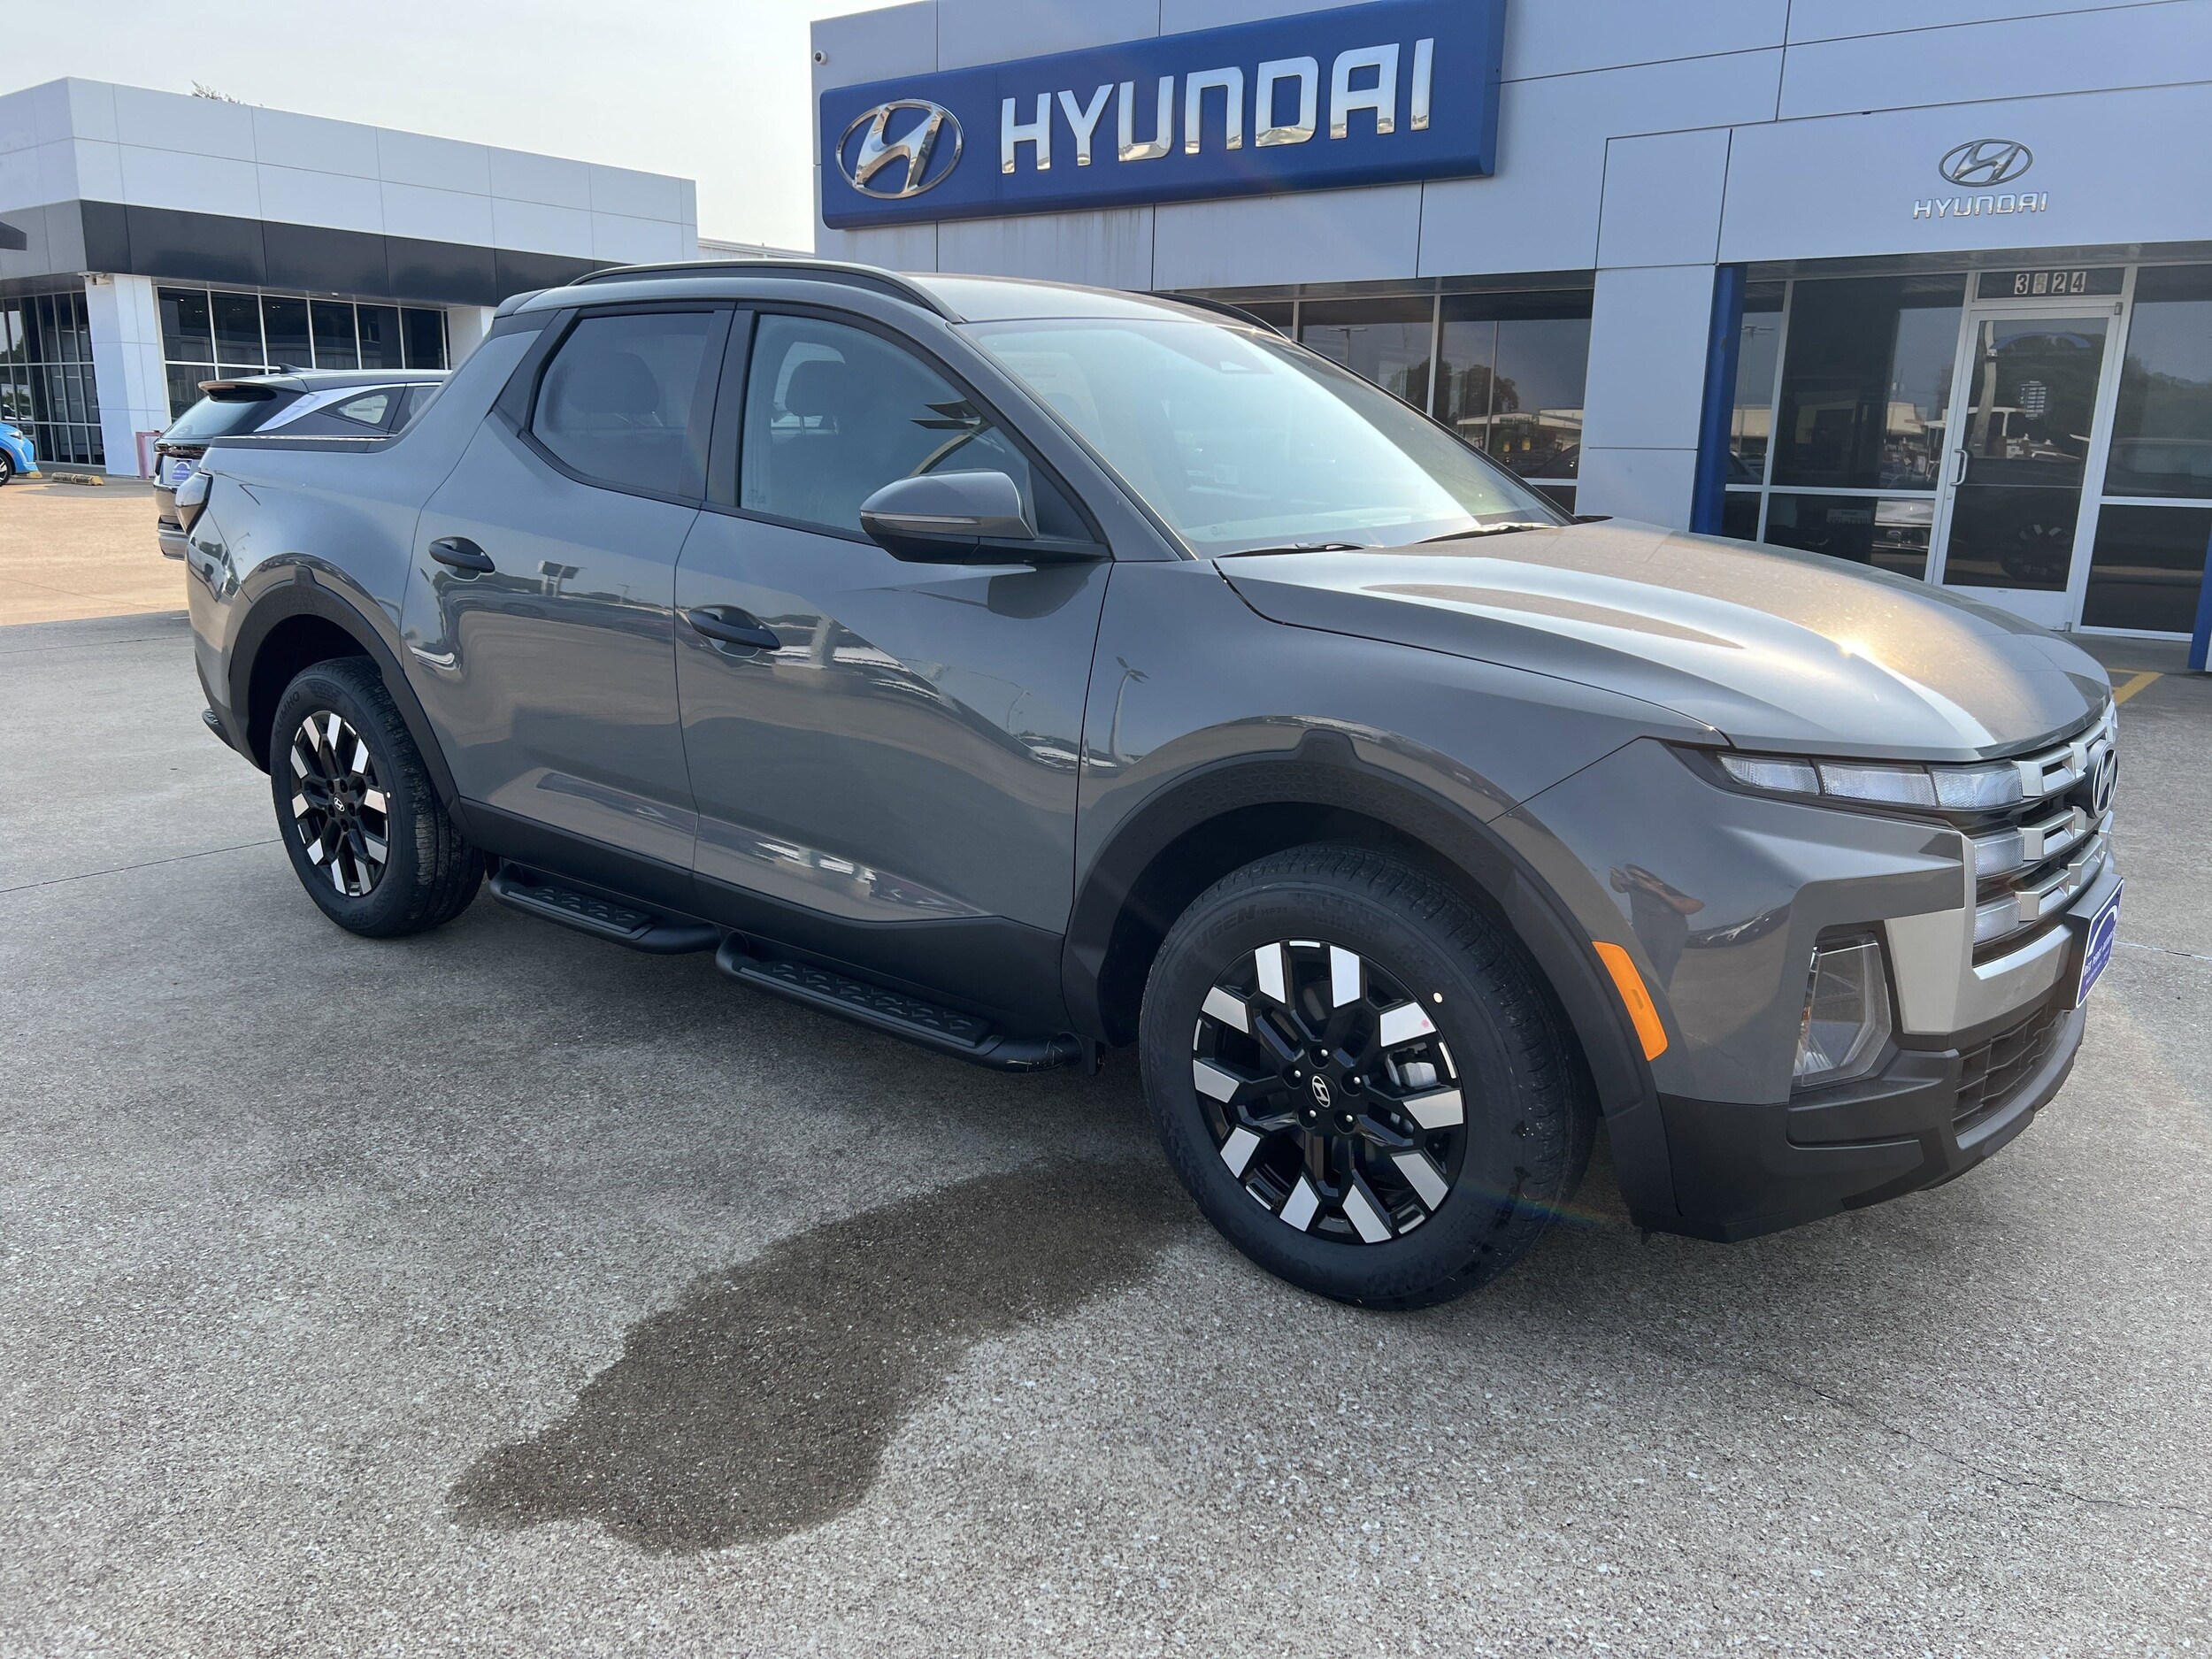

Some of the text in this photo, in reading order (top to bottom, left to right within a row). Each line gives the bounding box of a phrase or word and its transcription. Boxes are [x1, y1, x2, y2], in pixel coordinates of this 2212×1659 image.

[1002, 38, 1434, 174] HYUNDAI
[1913, 191, 2048, 219] HYUNDAI
[274, 691, 300, 739] KUMHO
